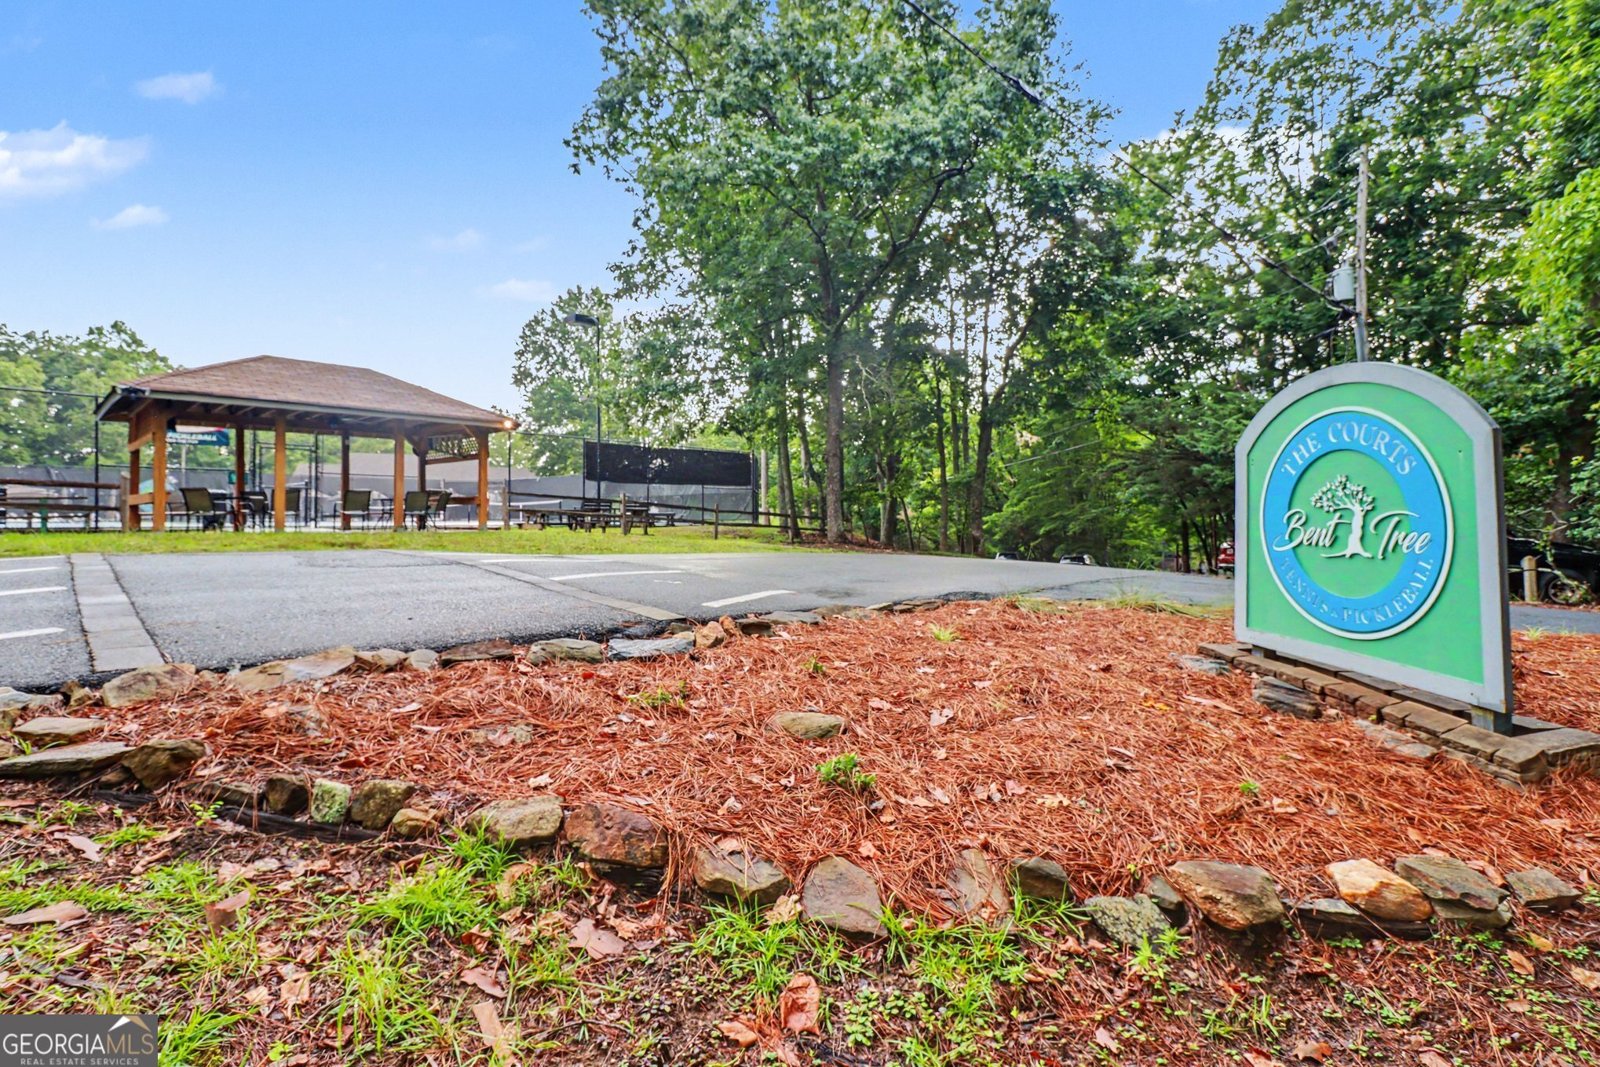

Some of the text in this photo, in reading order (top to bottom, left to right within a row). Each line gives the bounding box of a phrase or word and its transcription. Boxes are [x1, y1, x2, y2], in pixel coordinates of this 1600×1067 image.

[1281, 421, 1417, 476] THE COURTS
[1272, 508, 1431, 560] Bent Tree
[1280, 557, 1328, 613] TENNIS
[1343, 559, 1434, 624] PICKLEBALL
